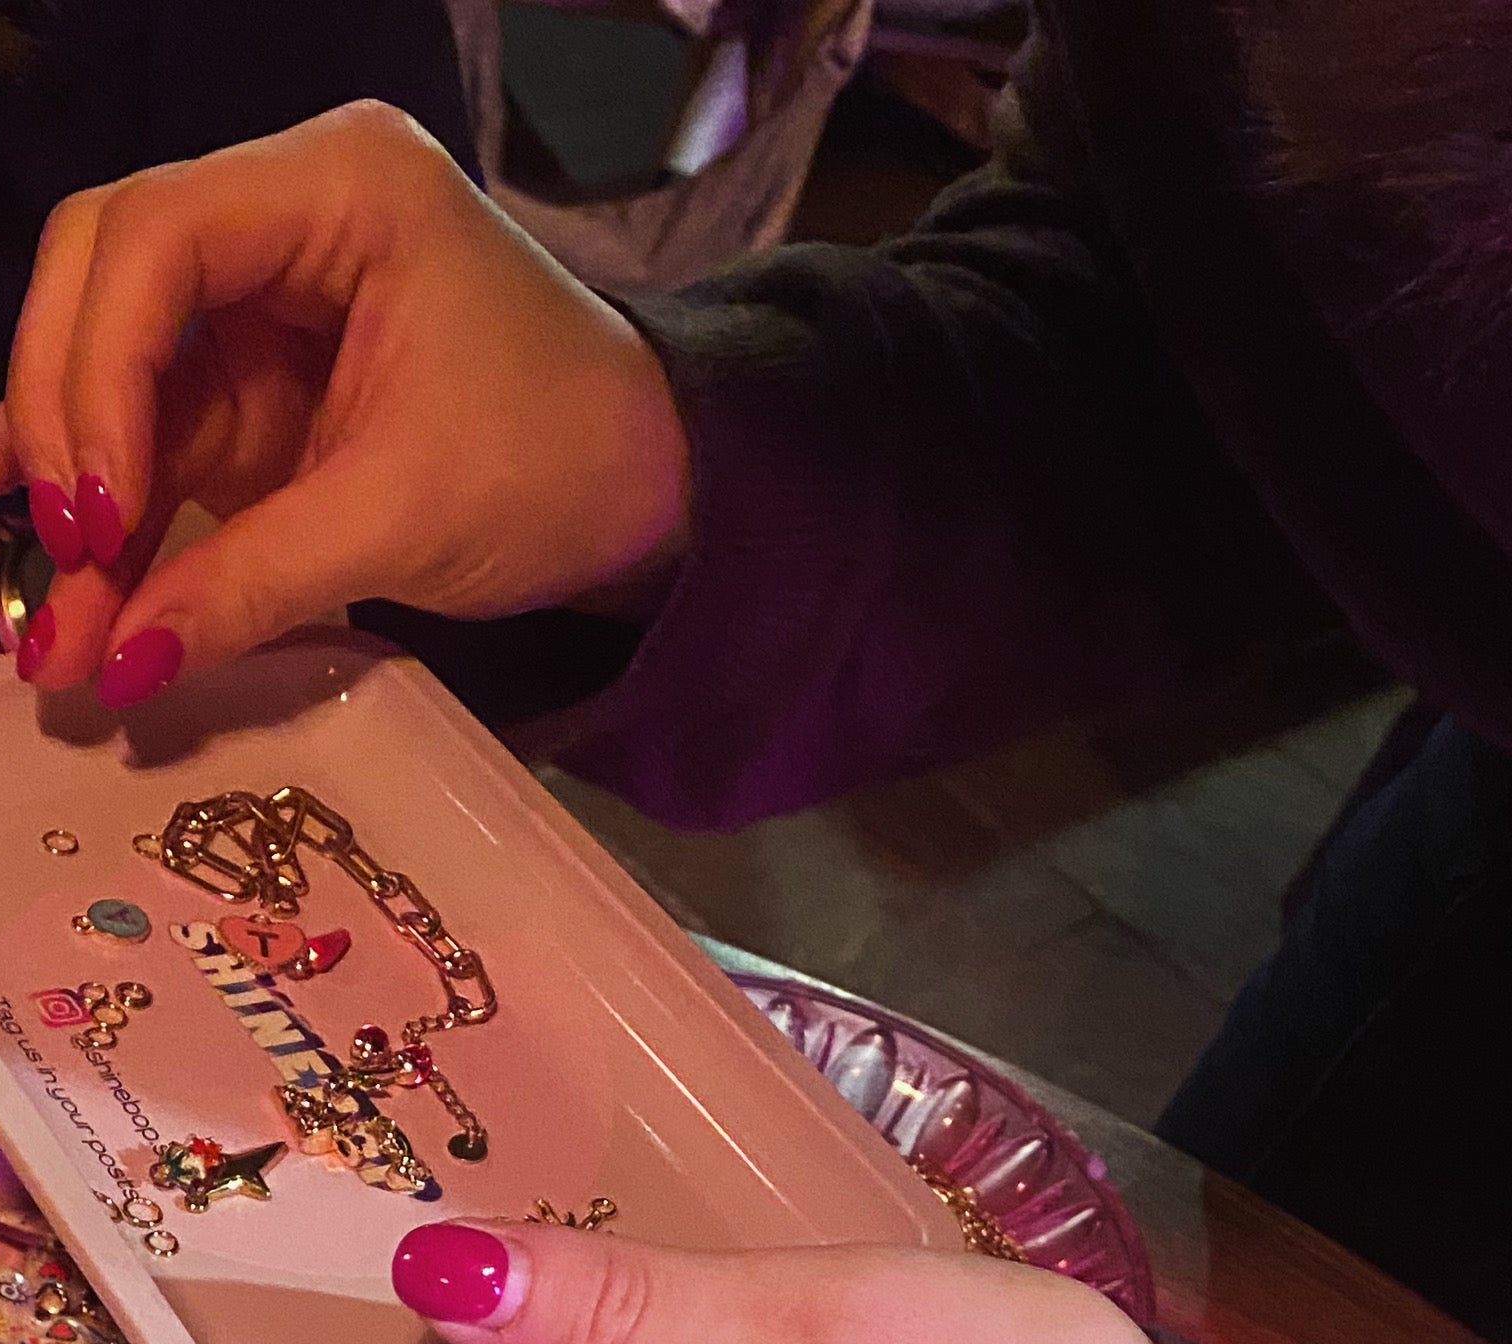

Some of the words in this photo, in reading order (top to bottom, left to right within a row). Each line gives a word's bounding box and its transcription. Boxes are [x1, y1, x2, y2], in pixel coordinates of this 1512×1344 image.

[246, 928, 280, 959] T
[168, 920, 335, 1090] SHINE
[17, 1038, 43, 1063] us
[37, 1066, 58, 1085] in
[45, 1086, 95, 1137] your
[81, 1135, 141, 1199] posts
